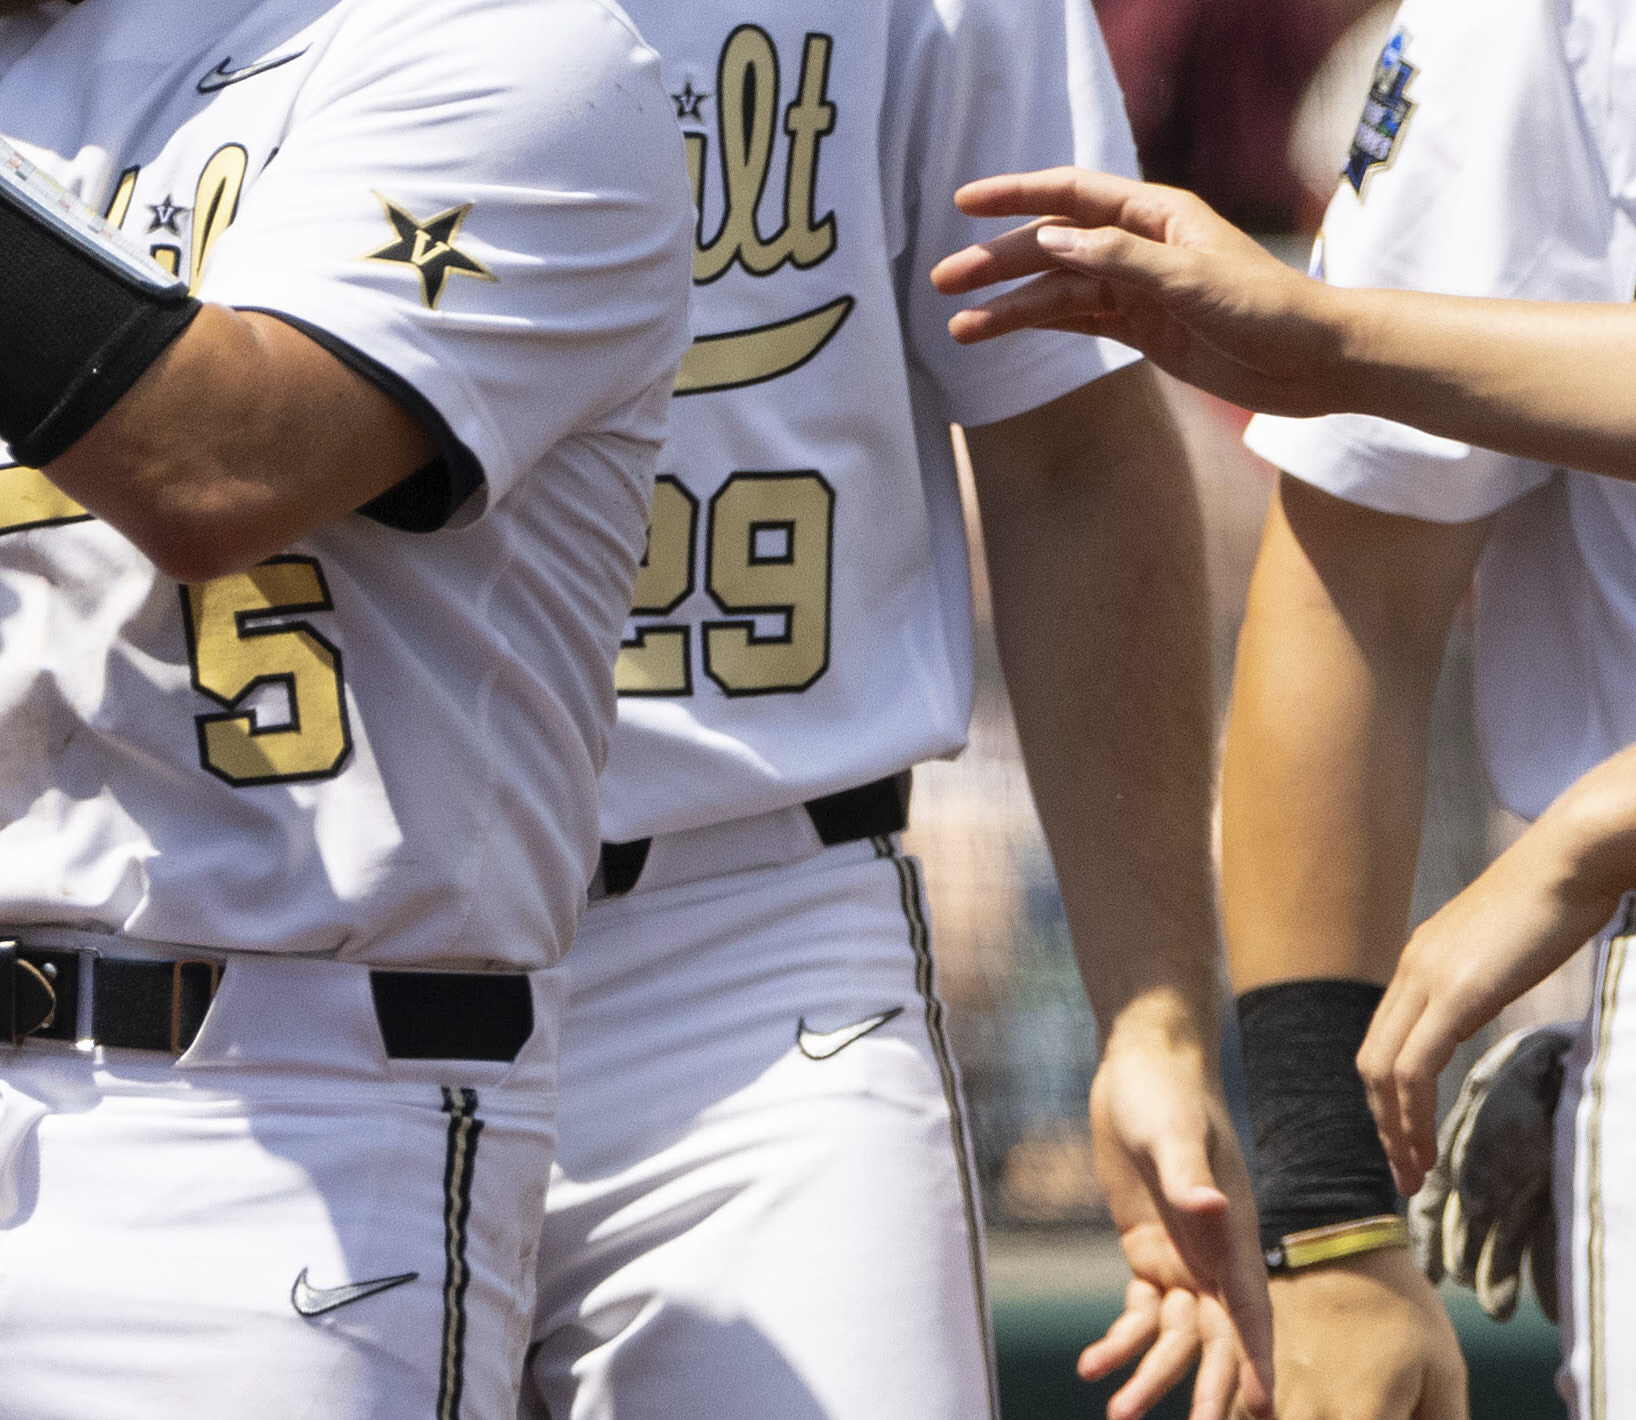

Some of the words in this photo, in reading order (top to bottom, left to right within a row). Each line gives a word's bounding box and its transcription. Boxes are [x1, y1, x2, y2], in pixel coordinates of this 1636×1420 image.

[412, 228, 451, 266] V
[179, 554, 353, 788] 5
[614, 469, 836, 698] 29
